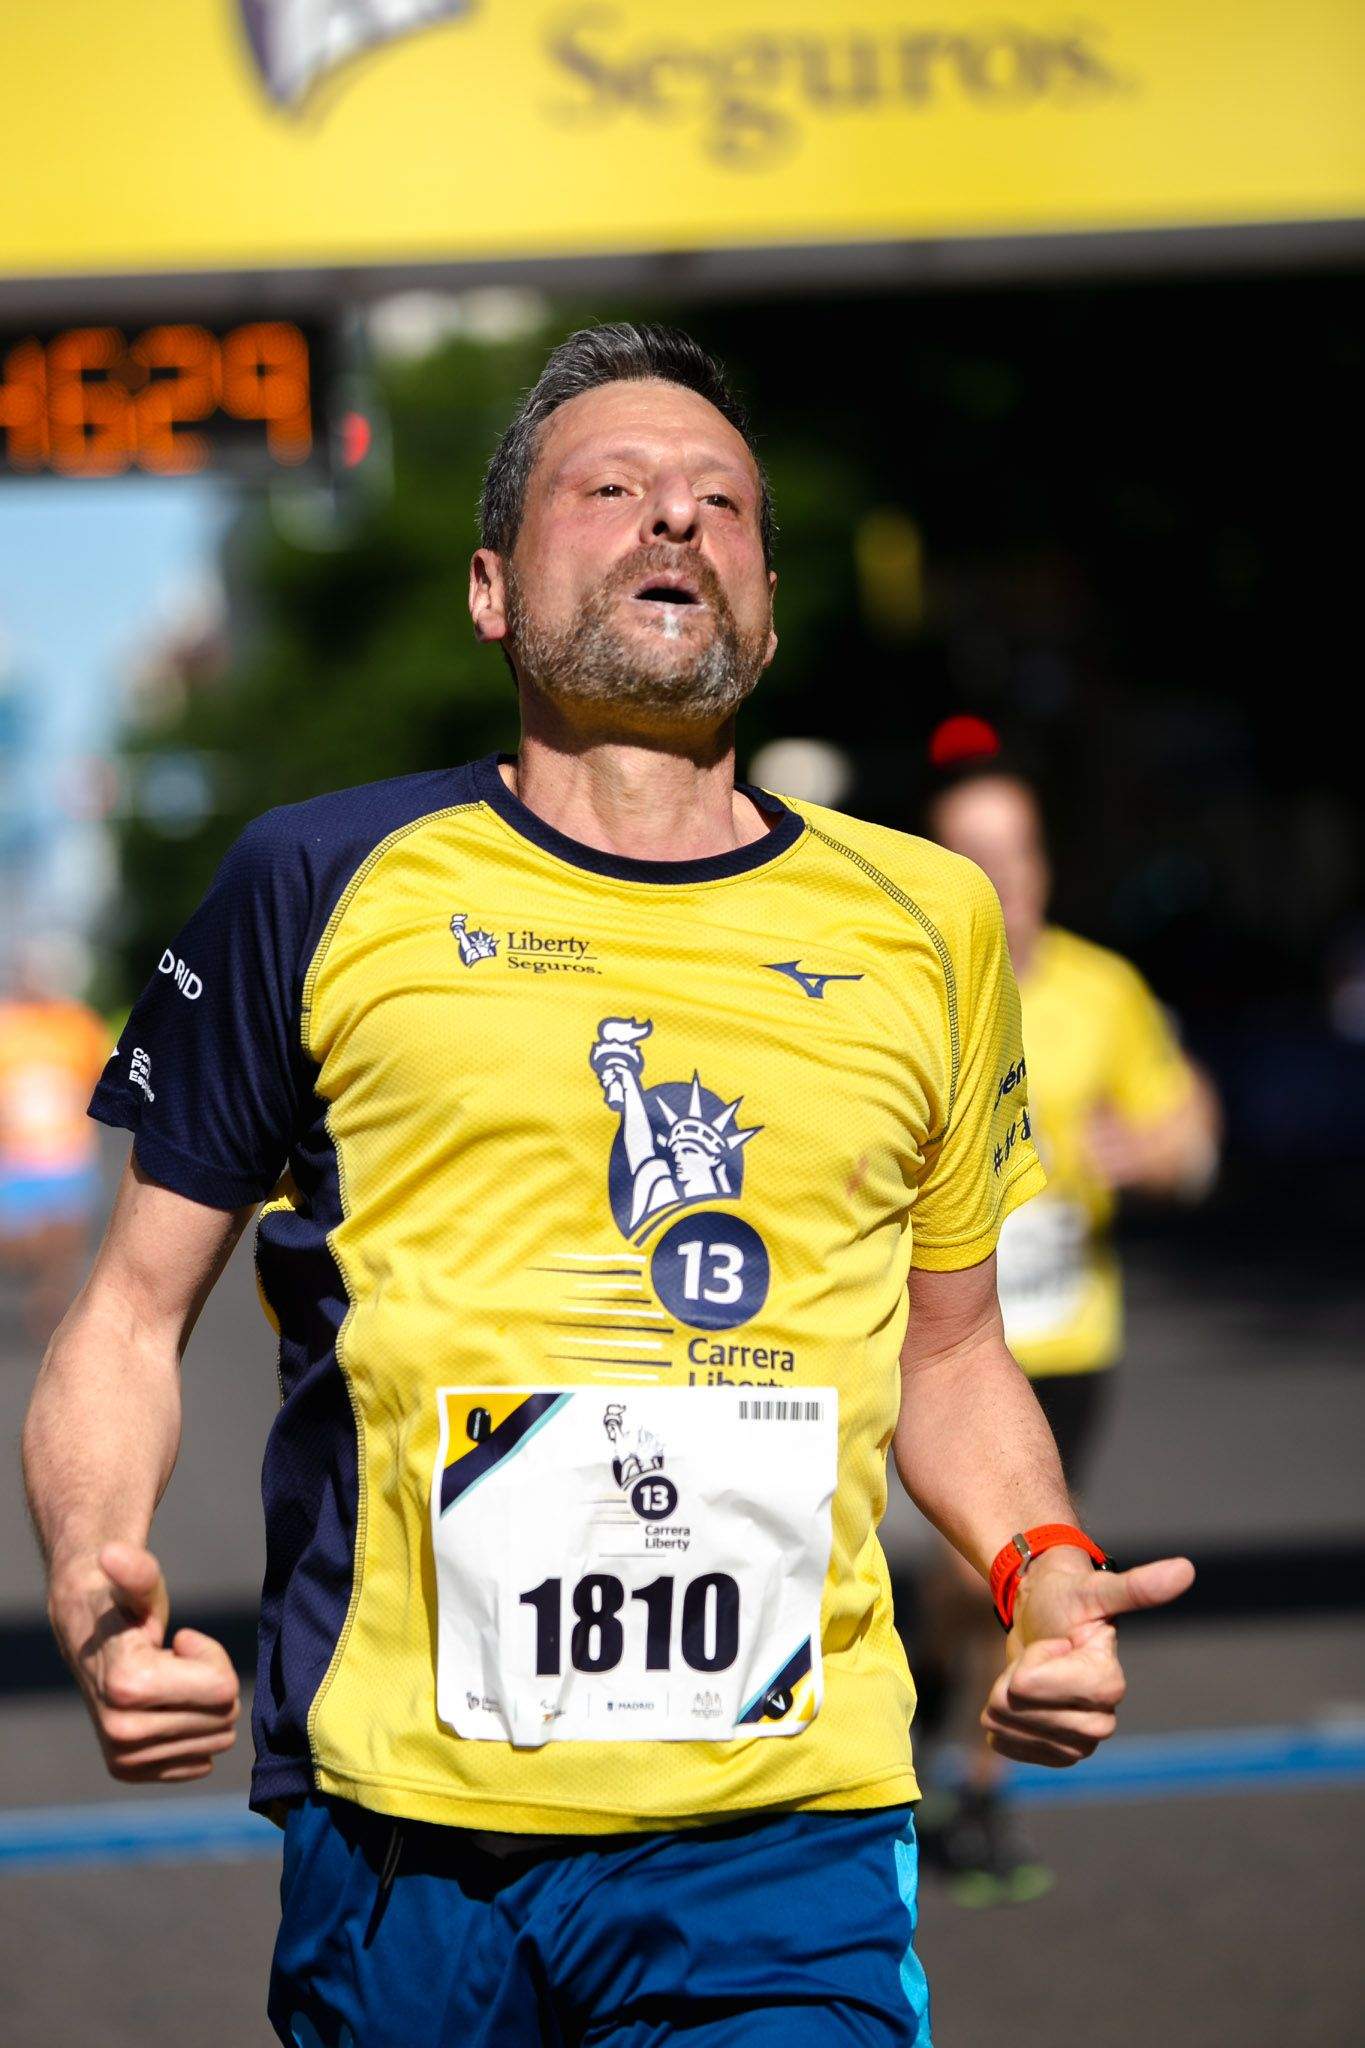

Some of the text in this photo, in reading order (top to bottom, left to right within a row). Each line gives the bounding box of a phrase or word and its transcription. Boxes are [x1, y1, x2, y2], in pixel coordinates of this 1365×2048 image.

[507, 931, 590, 960] Liberty
[507, 956, 602, 974] Seguros.
[677, 1240, 744, 1304] 13
[688, 1337, 795, 1372] Carrera
[640, 1484, 669, 1511] 13
[645, 1525, 691, 1536] Carrera
[645, 1538, 690, 1551] Liberty
[519, 1572, 740, 1678] 1810
